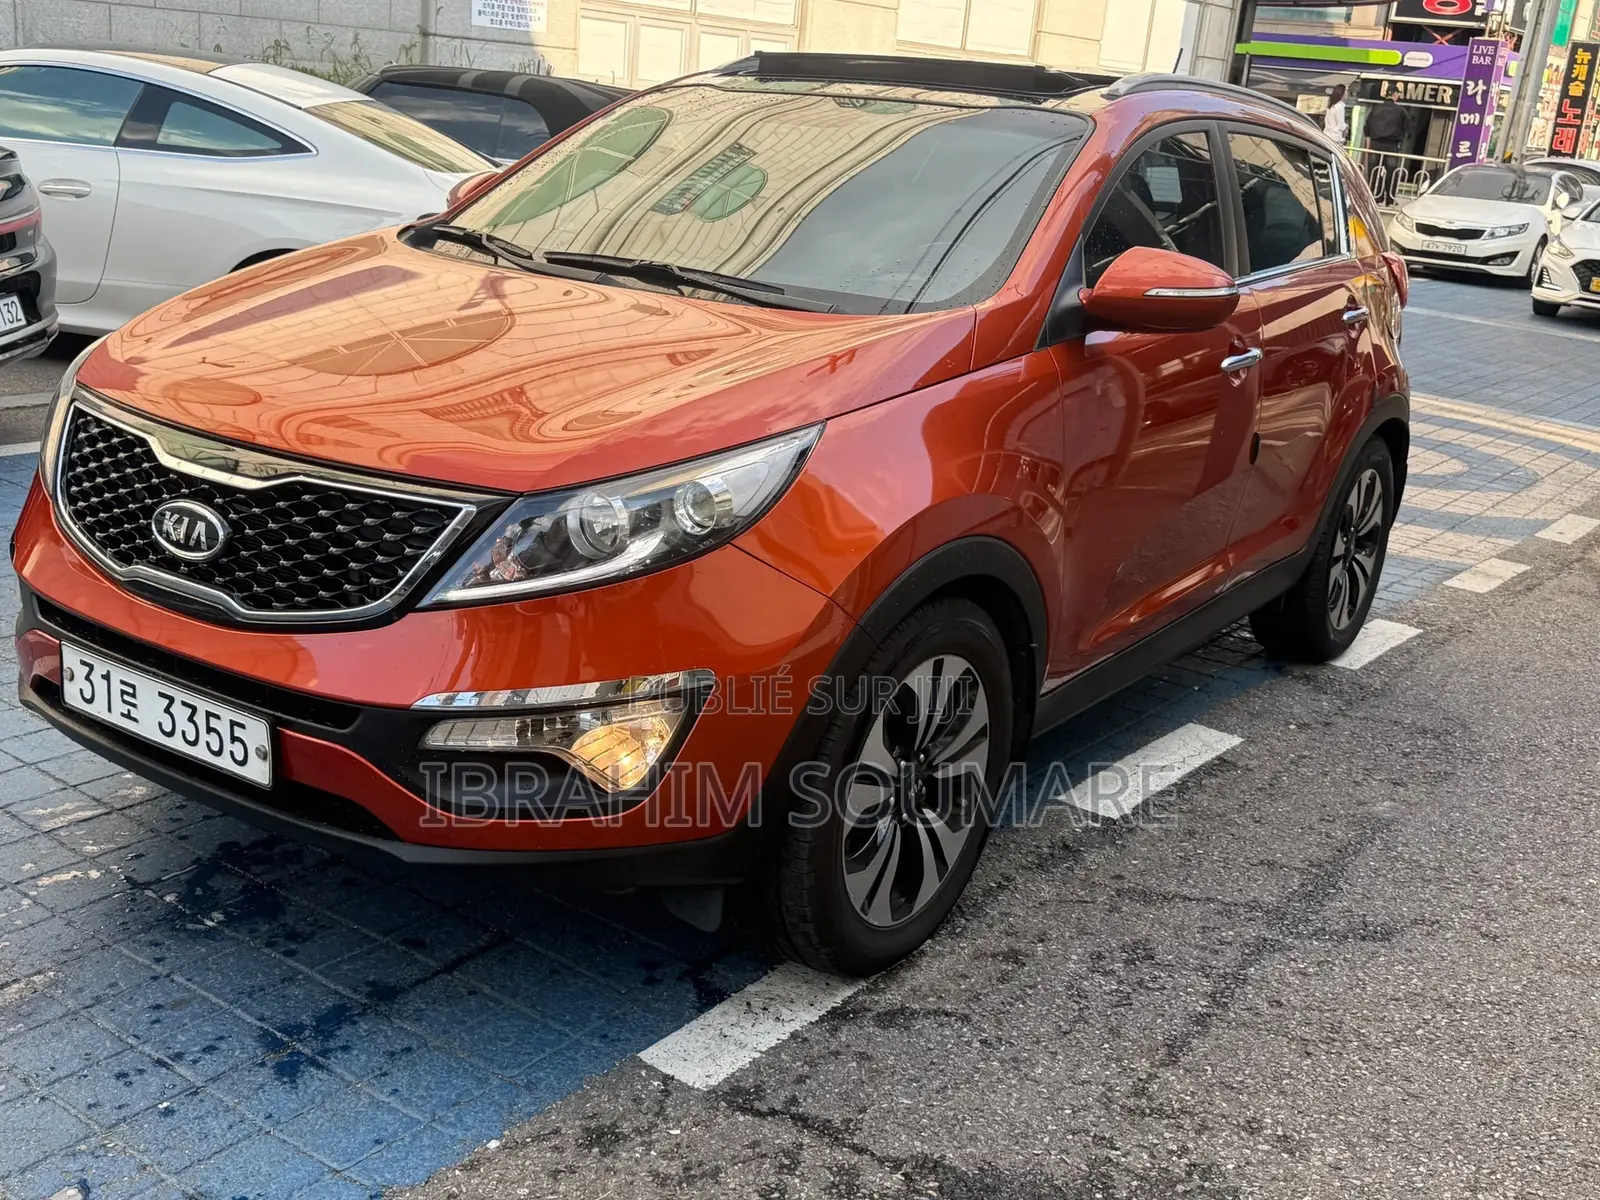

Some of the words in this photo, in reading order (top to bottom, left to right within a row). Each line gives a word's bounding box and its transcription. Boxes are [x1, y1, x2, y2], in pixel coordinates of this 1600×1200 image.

[1471, 55, 1492, 65] BAR
[1473, 45, 1495, 55] LIVE
[1380, 80, 1453, 104] LAMER
[1568, 49, 1592, 97] 뉴캐슬
[1455, 79, 1487, 158] 라메르
[1552, 99, 1581, 154] 노래
[161, 510, 208, 551] KIA
[79, 658, 139, 724] 31로
[157, 690, 249, 766] 3355
